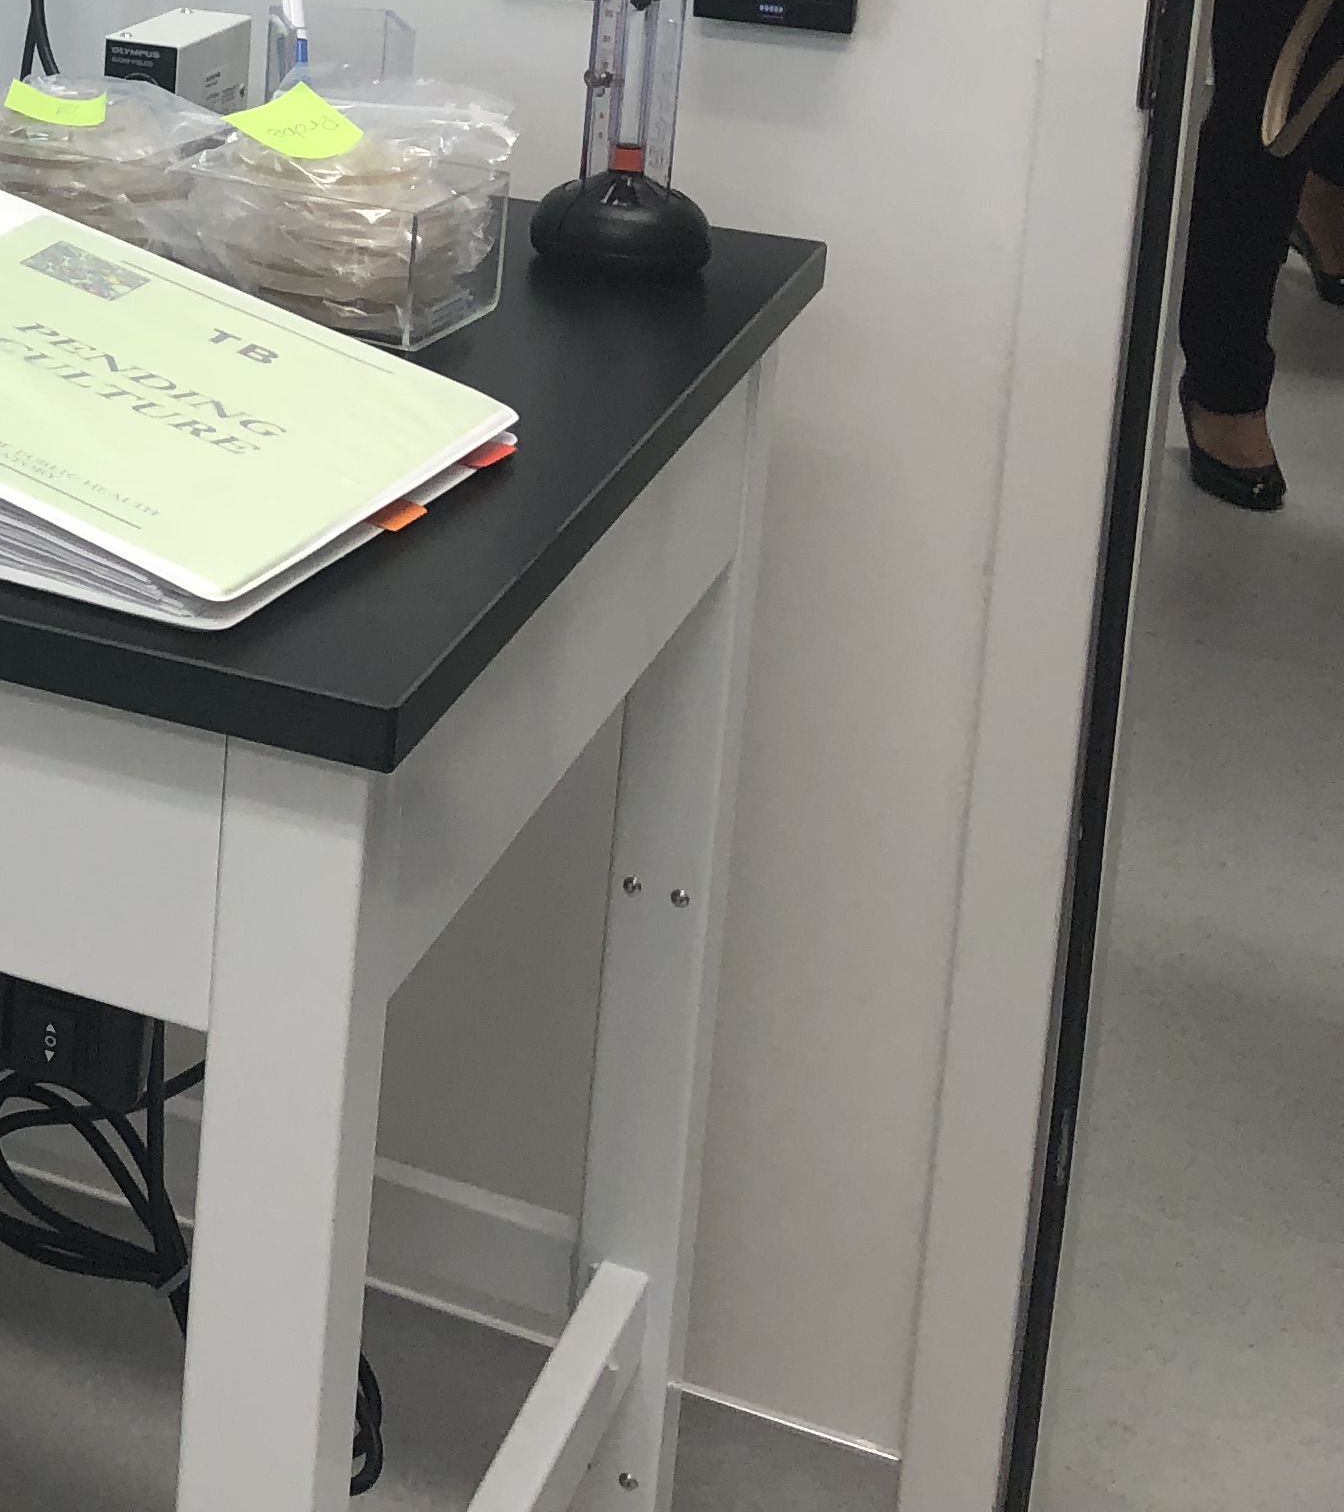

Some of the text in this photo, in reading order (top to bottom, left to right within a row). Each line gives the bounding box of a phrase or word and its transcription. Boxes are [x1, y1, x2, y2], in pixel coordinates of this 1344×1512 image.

[111, 46, 161, 59] OLYMPUS
[209, 328, 279, 364] TB
[13, 322, 287, 437] PENDING
